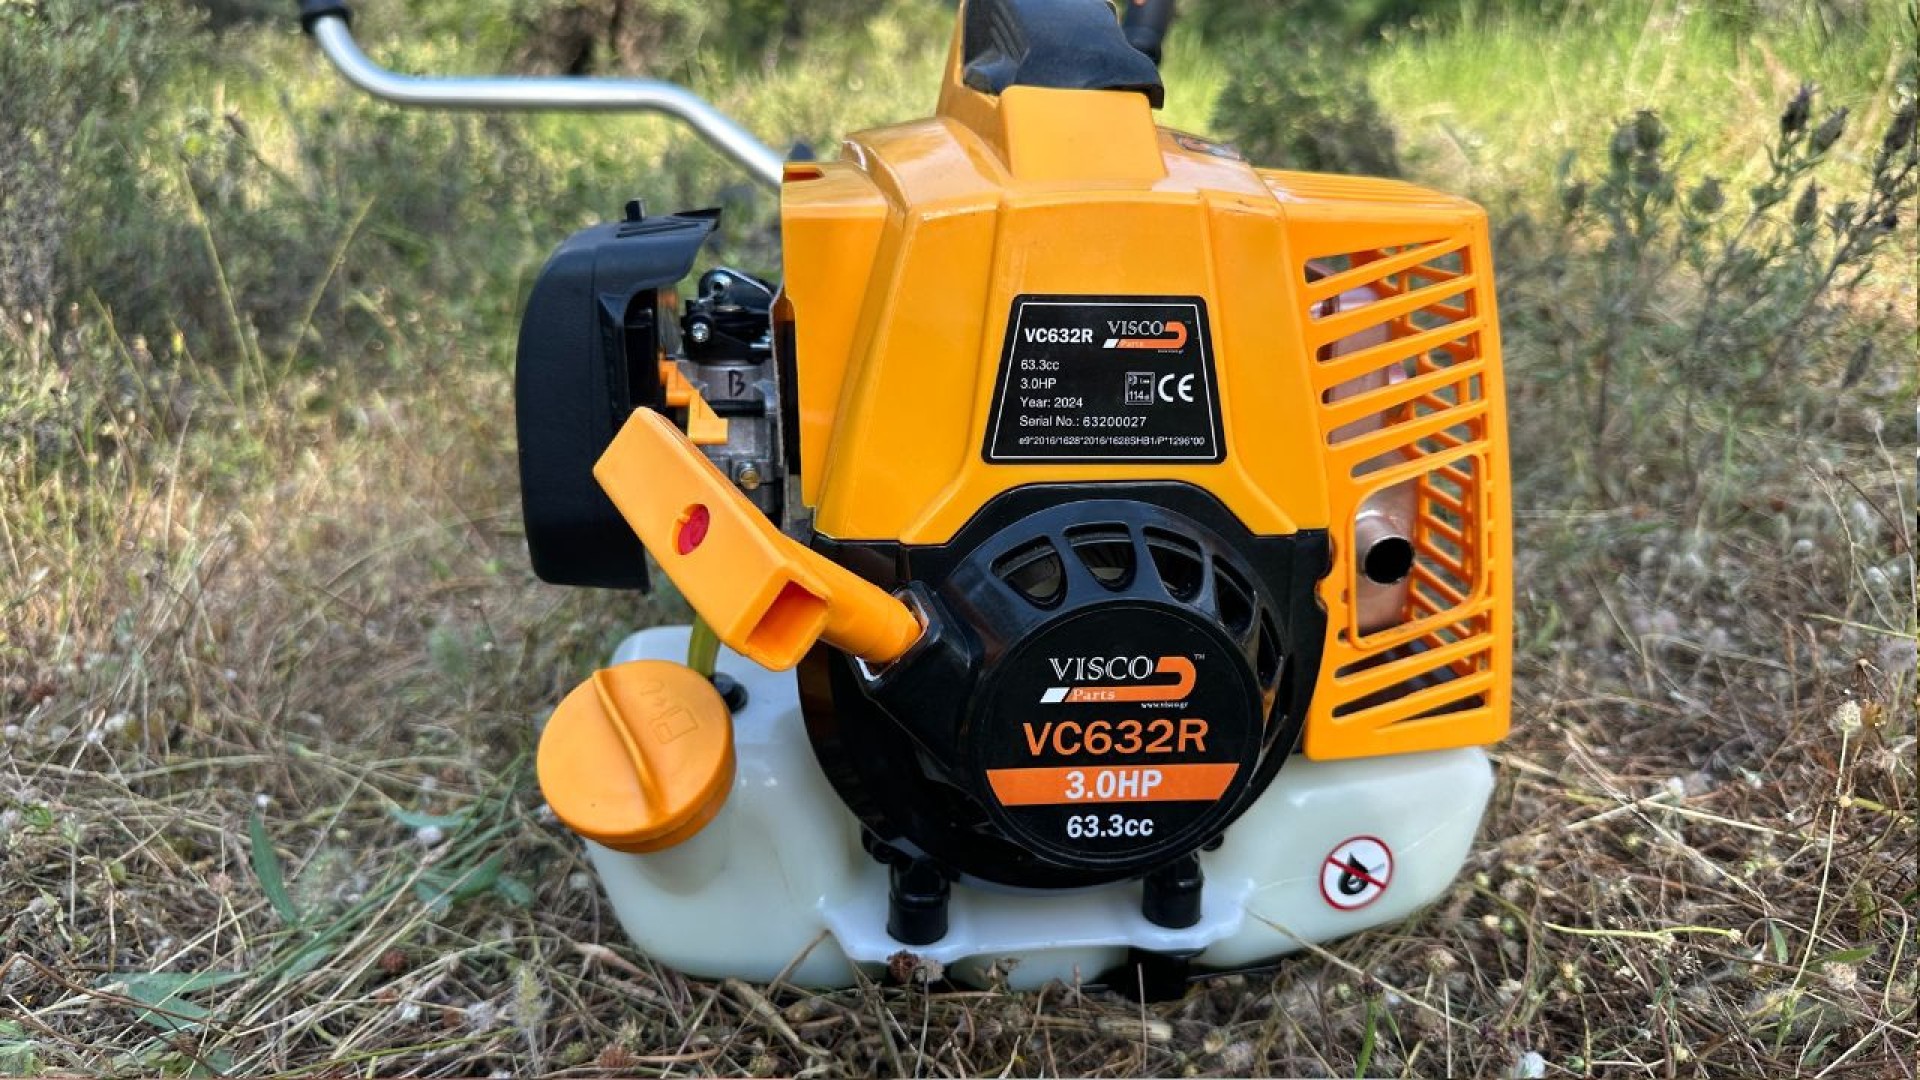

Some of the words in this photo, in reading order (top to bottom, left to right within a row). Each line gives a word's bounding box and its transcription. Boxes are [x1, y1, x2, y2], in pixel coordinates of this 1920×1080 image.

[1024, 327, 1093, 343] VC632R
[1106, 320, 1164, 336] VISCO
[1020, 360, 1060, 370] 63.3cc
[1020, 378, 1057, 389] 3.0HP
[1158, 373, 1195, 403] CE
[1019, 397, 1051, 409] Year:
[1053, 397, 1084, 409] 2024
[1019, 415, 1053, 428] Serial
[1055, 415, 1080, 428] No.:
[1082, 416, 1147, 428] 63200027
[1049, 655, 1153, 681] VISCO
[1072, 687, 1116, 700] Parts
[1022, 718, 1209, 757] VC632R
[1064, 769, 1163, 800] 3.0HP
[1066, 814, 1154, 839] 63.3cc
